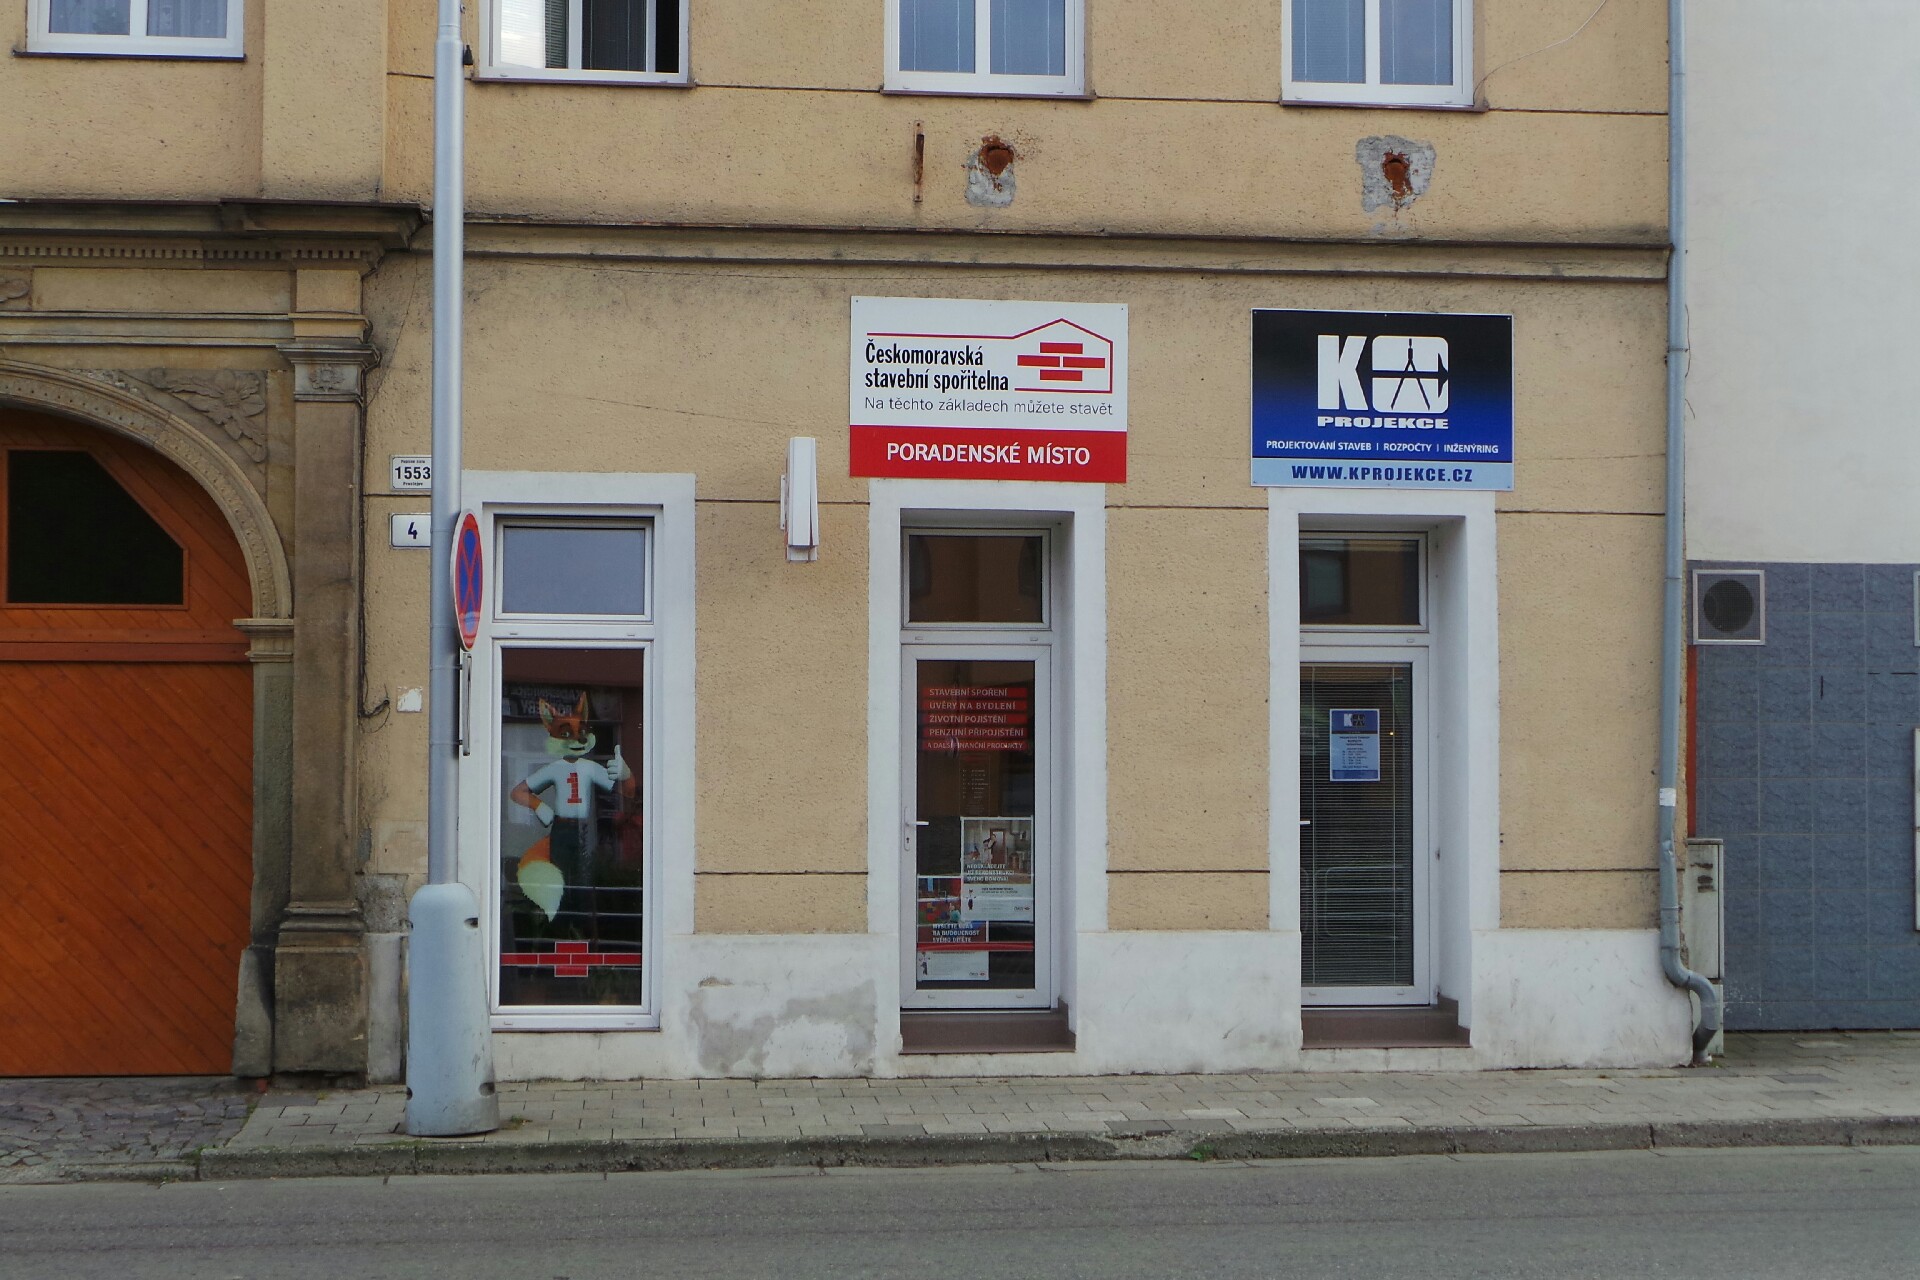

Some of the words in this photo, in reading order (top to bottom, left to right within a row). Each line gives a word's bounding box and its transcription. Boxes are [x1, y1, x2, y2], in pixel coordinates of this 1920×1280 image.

[865, 339, 983, 366] Českomoravská
[865, 368, 929, 389] stavební
[933, 370, 1009, 393] spořitelna
[865, 397, 884, 410] Na
[889, 397, 934, 411] těchto
[938, 398, 1008, 412] základech
[1014, 400, 1065, 414] můžete
[1069, 402, 1113, 416] stavět
[1317, 416, 1449, 430] PROJEKCE
[887, 442, 1021, 464] PORADENSKÉ
[1028, 443, 1090, 465] MÍSTO
[1266, 440, 1336, 450] PROJEKTOVÁNÍ
[1338, 442, 1372, 451] STAVEB
[1383, 442, 1432, 453] ROZPOČTY
[1443, 443, 1499, 454] INŽENÝRING
[394, 466, 431, 480] 1553
[1291, 465, 1473, 482] WWW.KPROJEKCE.CZ
[407, 521, 418, 540] 4
[929, 687, 969, 696] STAVEBNÍ
[971, 687, 1008, 697] SPOŘENÍ
[959, 702, 973, 710] NA
[976, 701, 1016, 710] BYDLENÍ
[566, 772, 582, 804] 1
